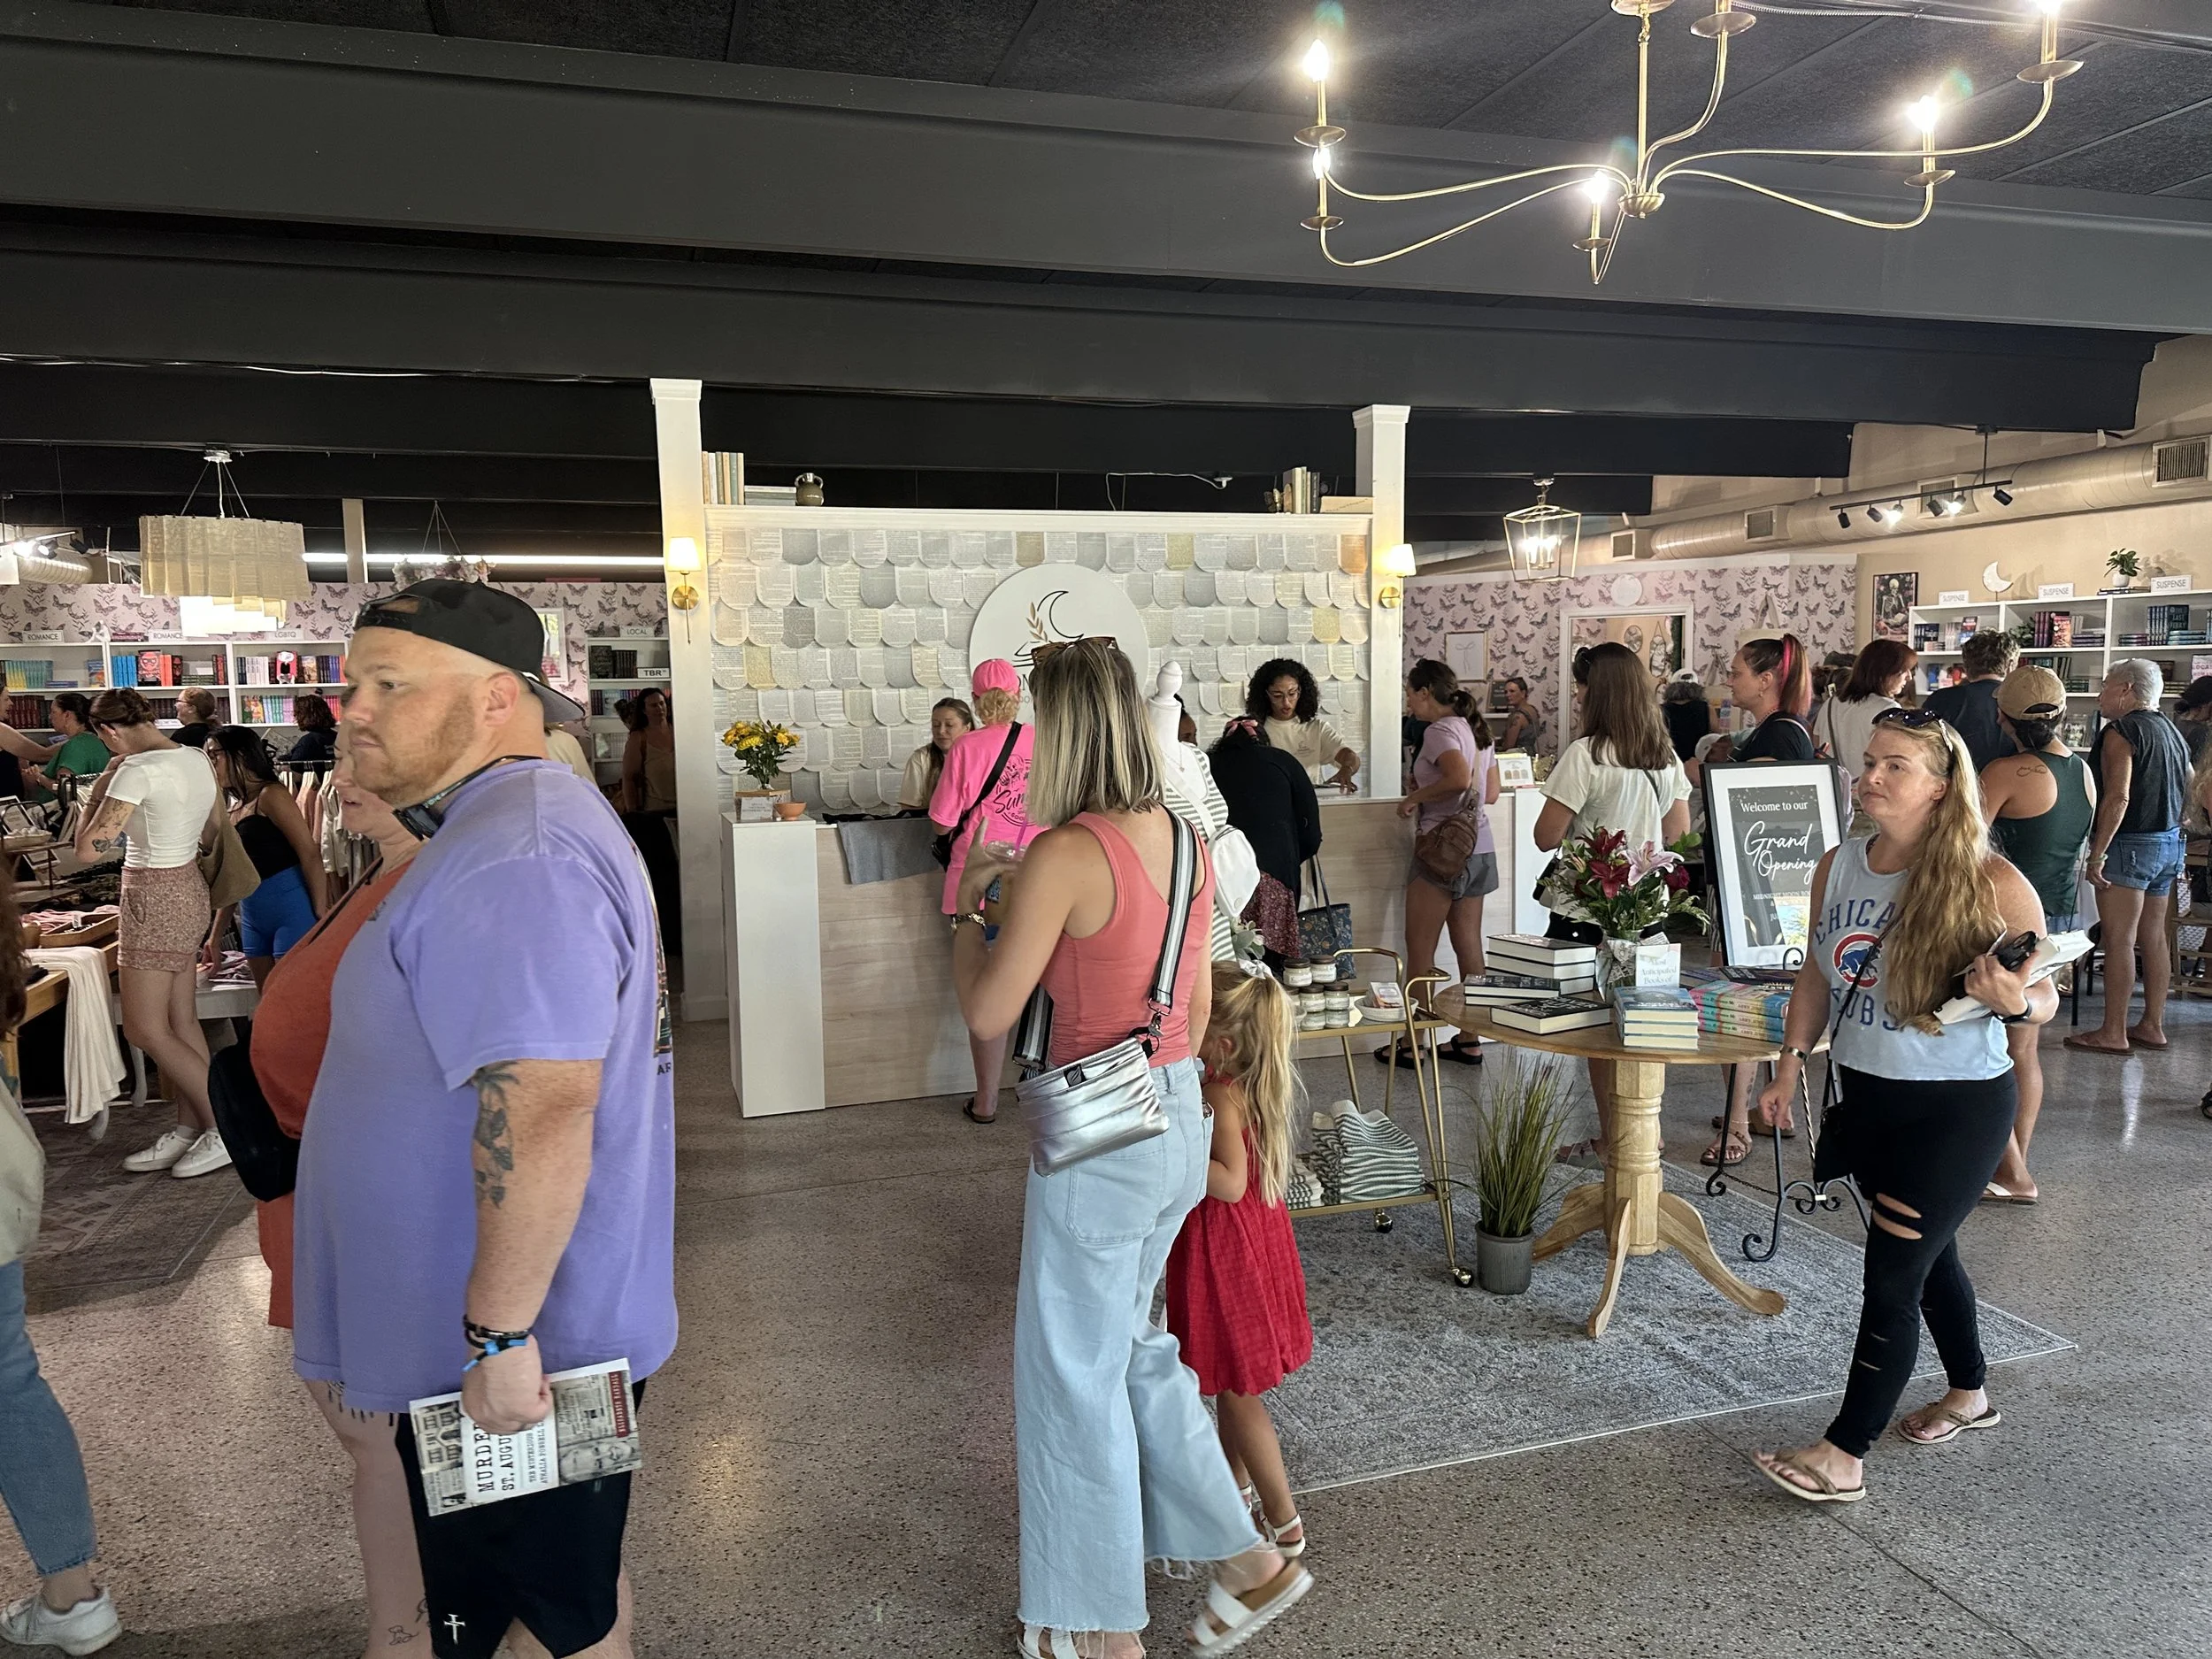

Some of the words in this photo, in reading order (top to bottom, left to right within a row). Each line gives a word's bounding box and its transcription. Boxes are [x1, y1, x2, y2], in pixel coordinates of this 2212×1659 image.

[2043, 587, 2070, 597] SUSPENSE
[2156, 579, 2186, 589] SUSPENSE
[1740, 803, 1779, 813] Welcome
[1782, 802, 1792, 811] to
[1793, 801, 1809, 810] our
[1744, 820, 1813, 867] Grand
[1758, 849, 1818, 885] Opening
[1815, 899, 1896, 945] CHICA
[1642, 966, 1677, 976] Anticipated
[473, 1424, 495, 1493] MURDE
[500, 1471, 514, 1490] ST.
